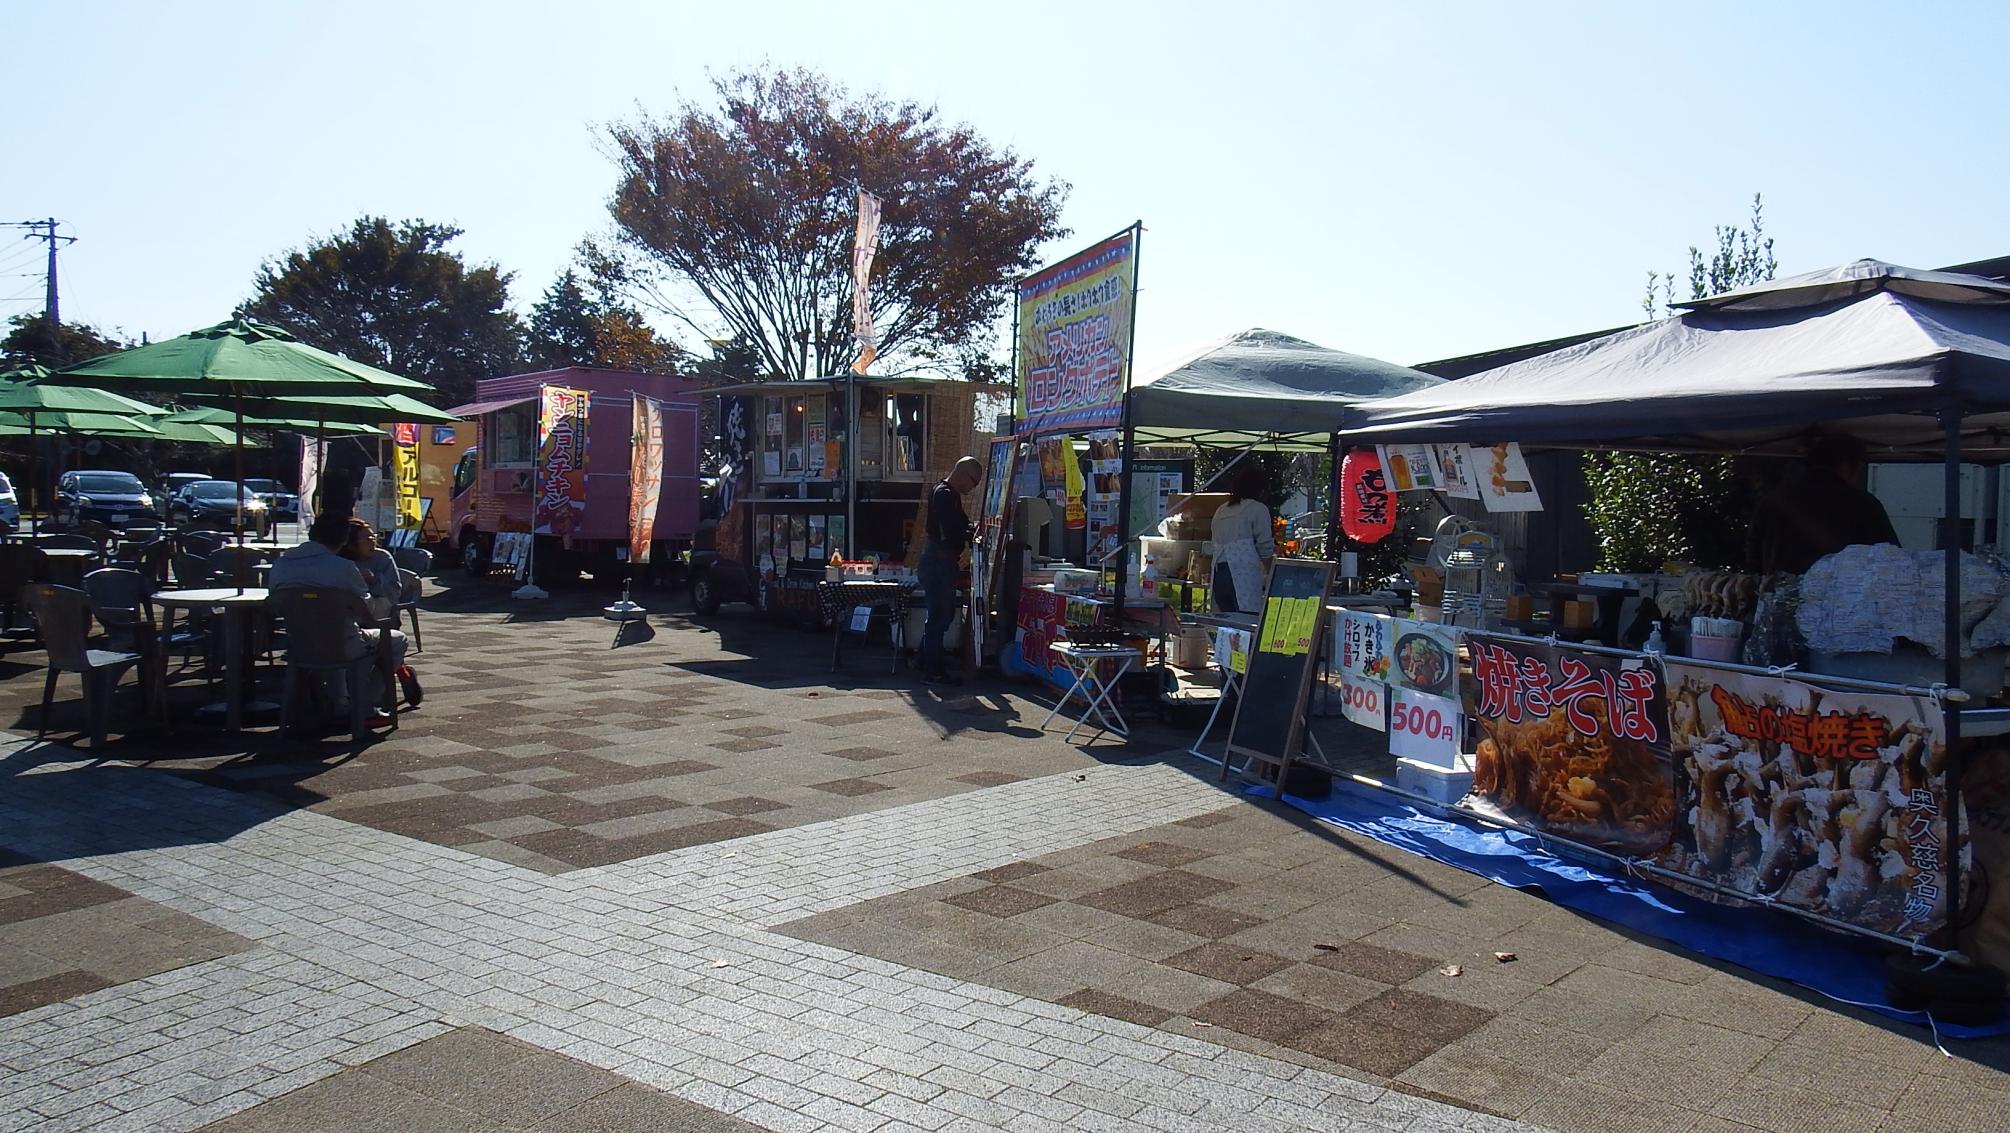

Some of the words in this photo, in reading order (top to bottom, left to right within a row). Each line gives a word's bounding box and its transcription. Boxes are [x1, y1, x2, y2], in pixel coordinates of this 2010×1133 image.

[1048, 315, 1110, 366] アメリカン
[1029, 350, 1121, 412] ロングポテト
[546, 391, 576, 510] ヤンニョムチキン
[1344, 616, 1352, 668] かけ放題
[1353, 619, 1361, 662] シロップ
[1364, 622, 1377, 671] かき氷
[1473, 641, 1657, 743] 焼きそば
[1393, 703, 1453, 741] 500円
[1711, 684, 1886, 759] 鮎の塩焼き
[1903, 788, 1940, 922] 奥久慈名物
